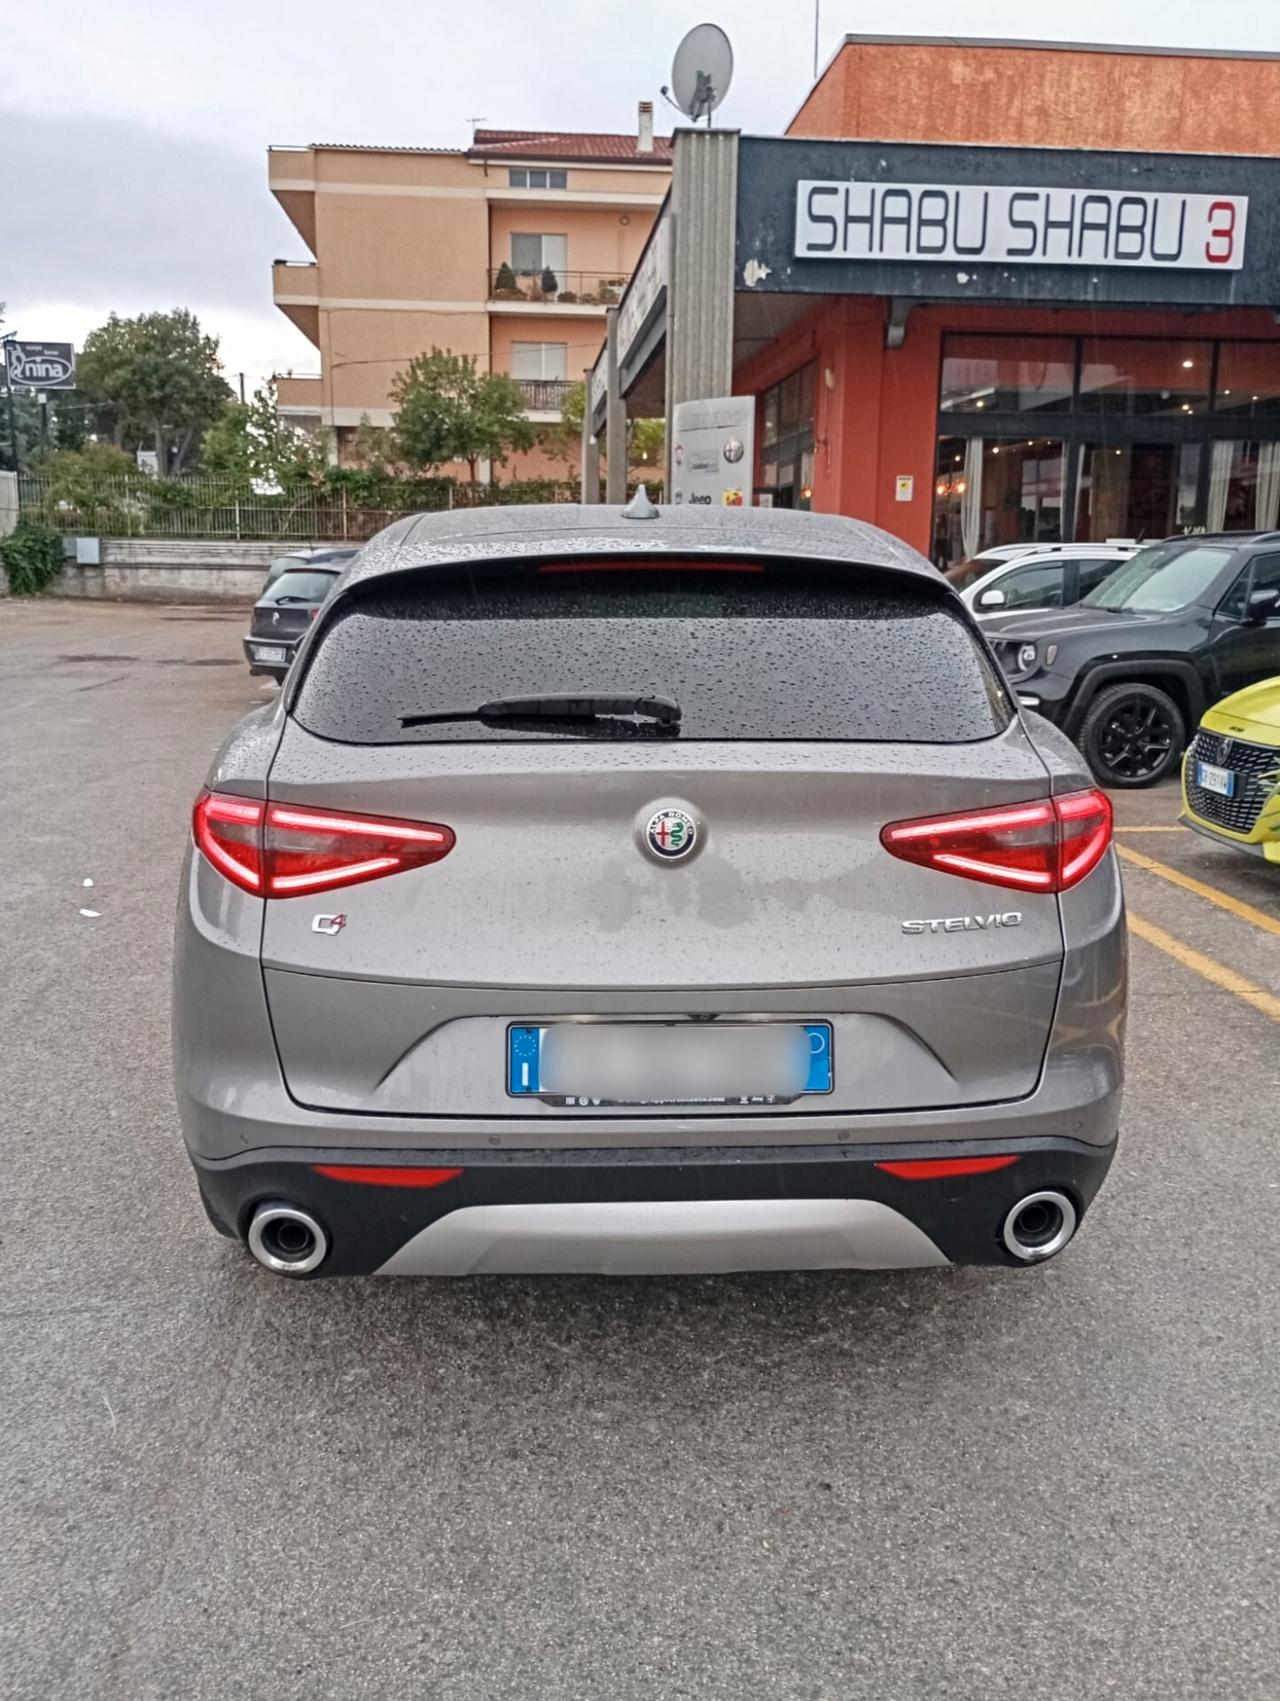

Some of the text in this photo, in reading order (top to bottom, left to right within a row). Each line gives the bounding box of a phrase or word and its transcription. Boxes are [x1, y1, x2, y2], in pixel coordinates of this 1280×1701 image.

[806, 187, 1236, 263] SHABU SHABU 3
[25, 358, 64, 378] nina
[648, 811, 695, 836] ALFA ROMEO
[901, 911, 1023, 934] STELVIO
